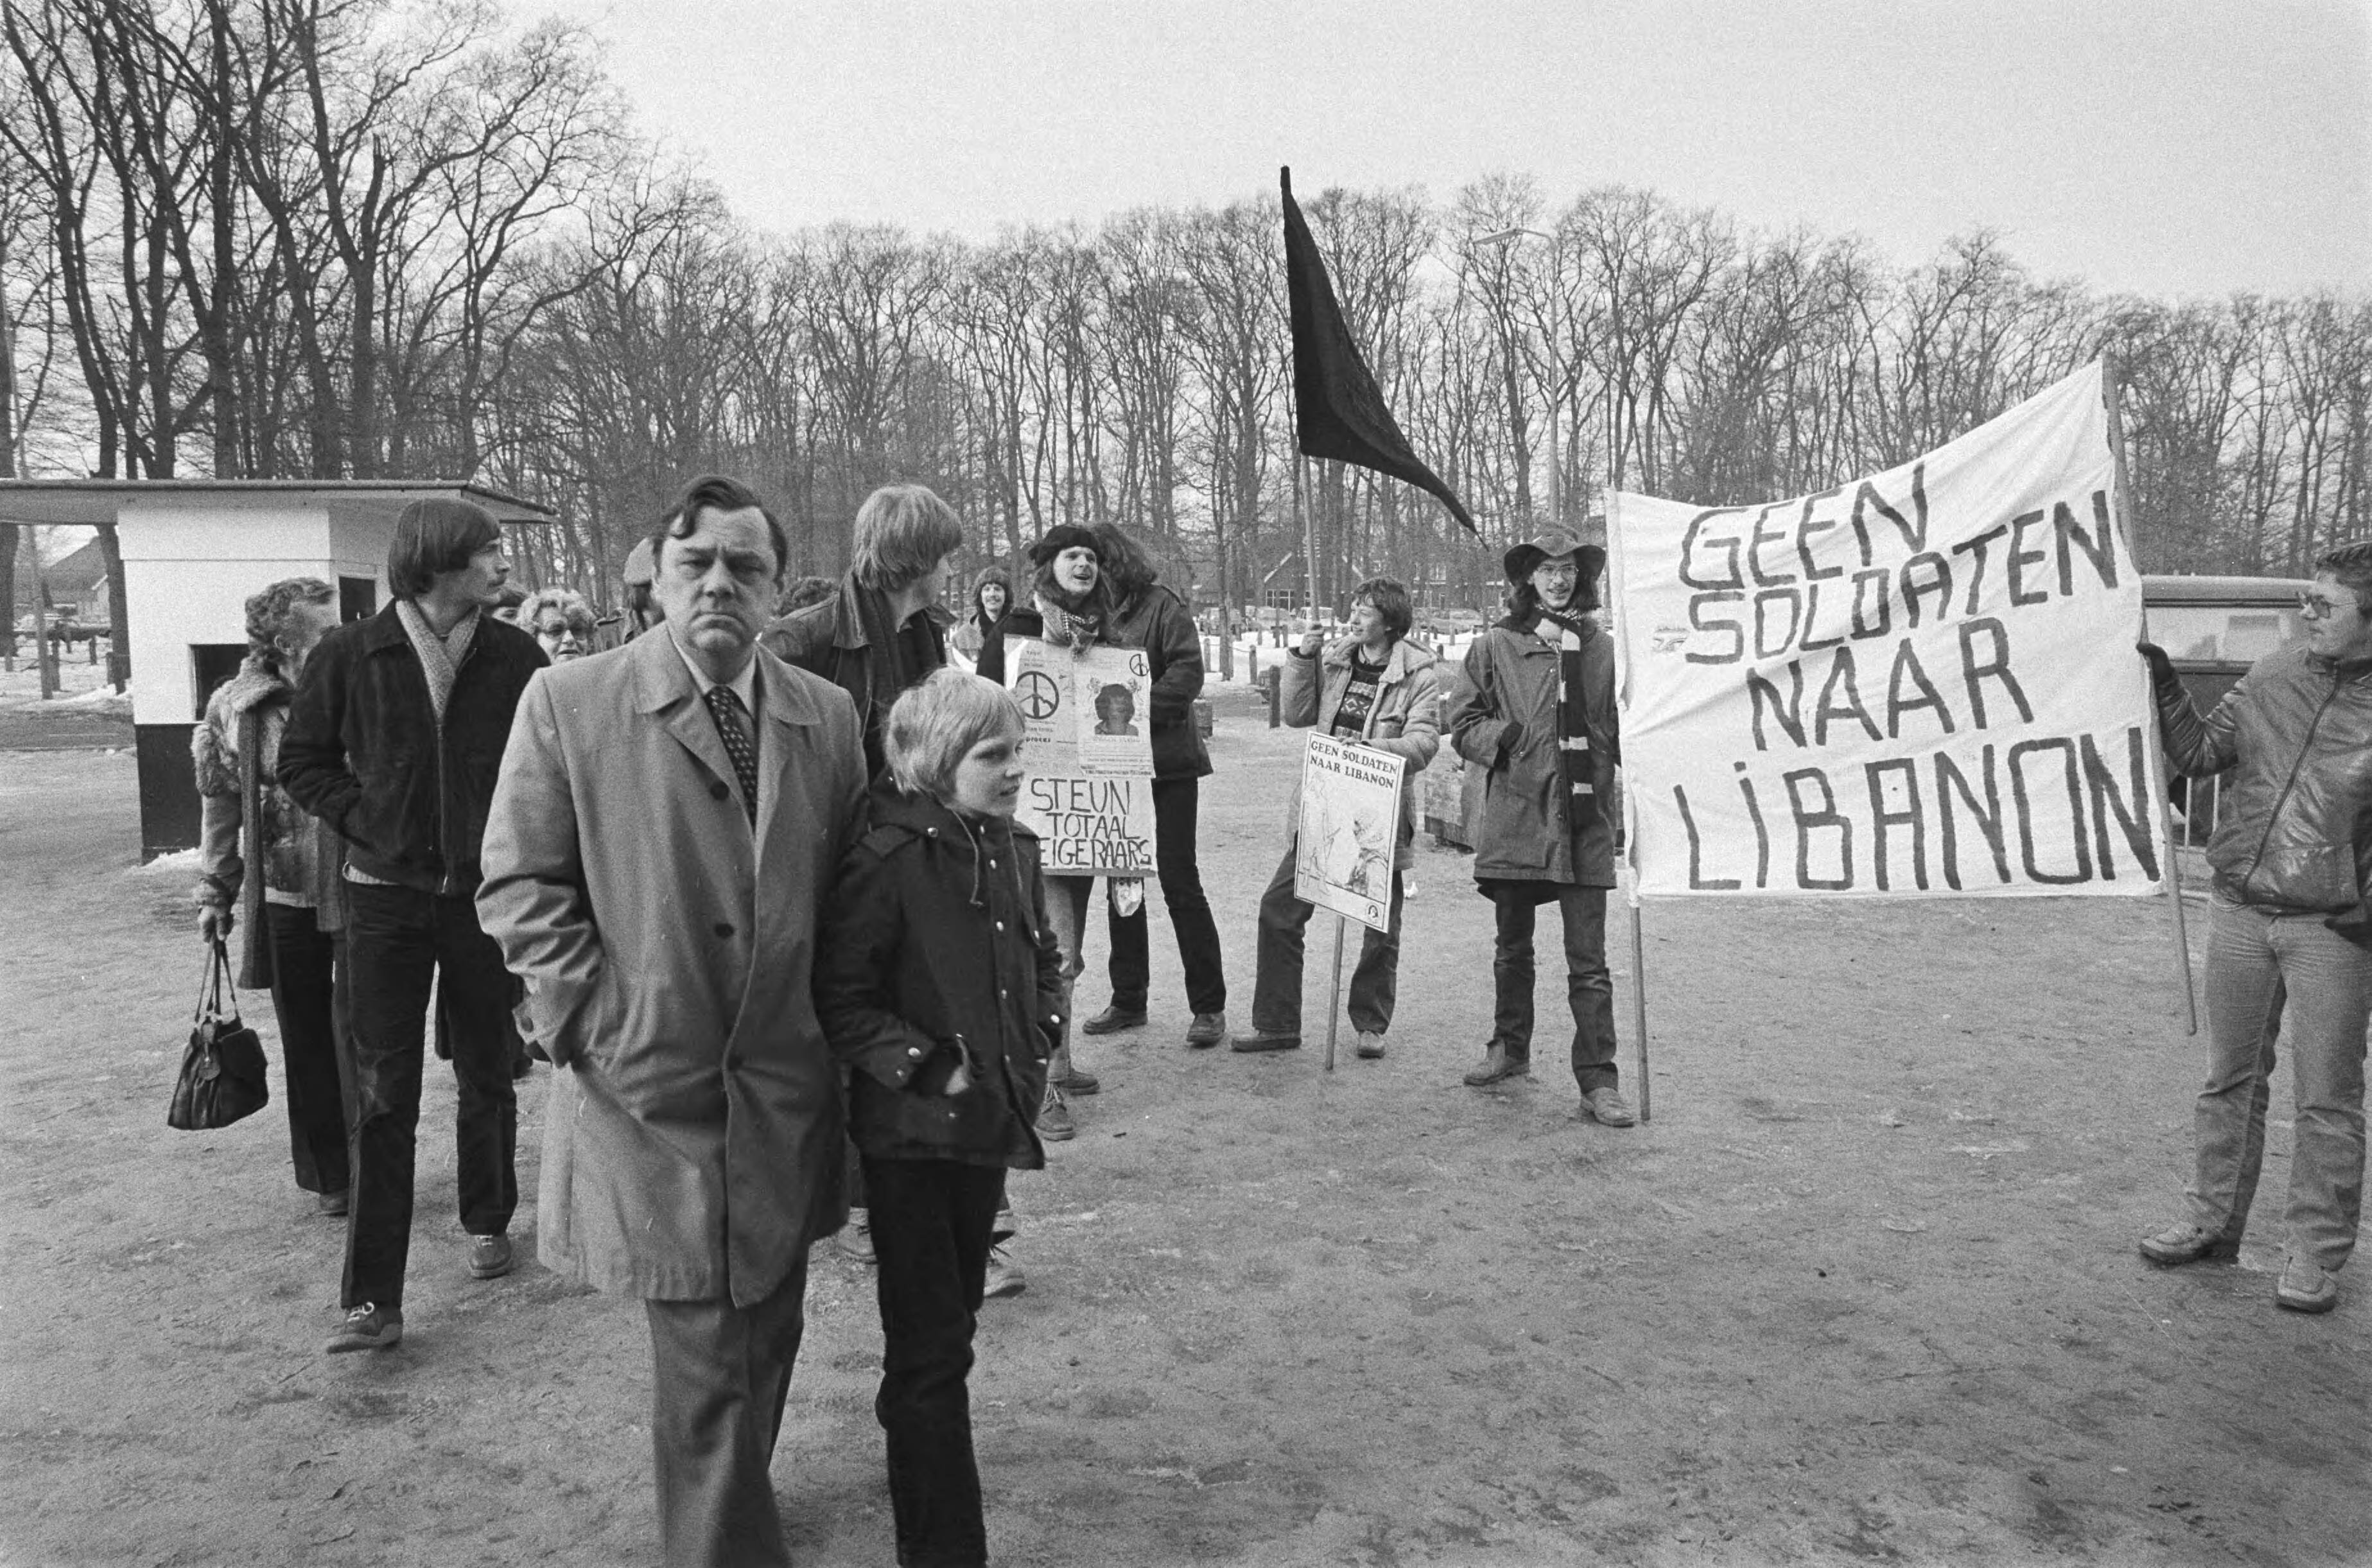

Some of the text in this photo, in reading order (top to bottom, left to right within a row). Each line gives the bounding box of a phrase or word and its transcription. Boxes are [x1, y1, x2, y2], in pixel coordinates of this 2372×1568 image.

[1679, 462, 1927, 591] GEEN
[1685, 489, 2119, 666] SOLDATEN
[1746, 618, 2034, 752] NAAR
[1309, 754, 1395, 789] NAAR LIBANON
[1311, 740, 1398, 774] GEEN SOLDATEN
[1031, 778, 1130, 815] STEUN
[1045, 812, 1141, 840] TOTAAL
[1038, 837, 1152, 868] EIGERAARS
